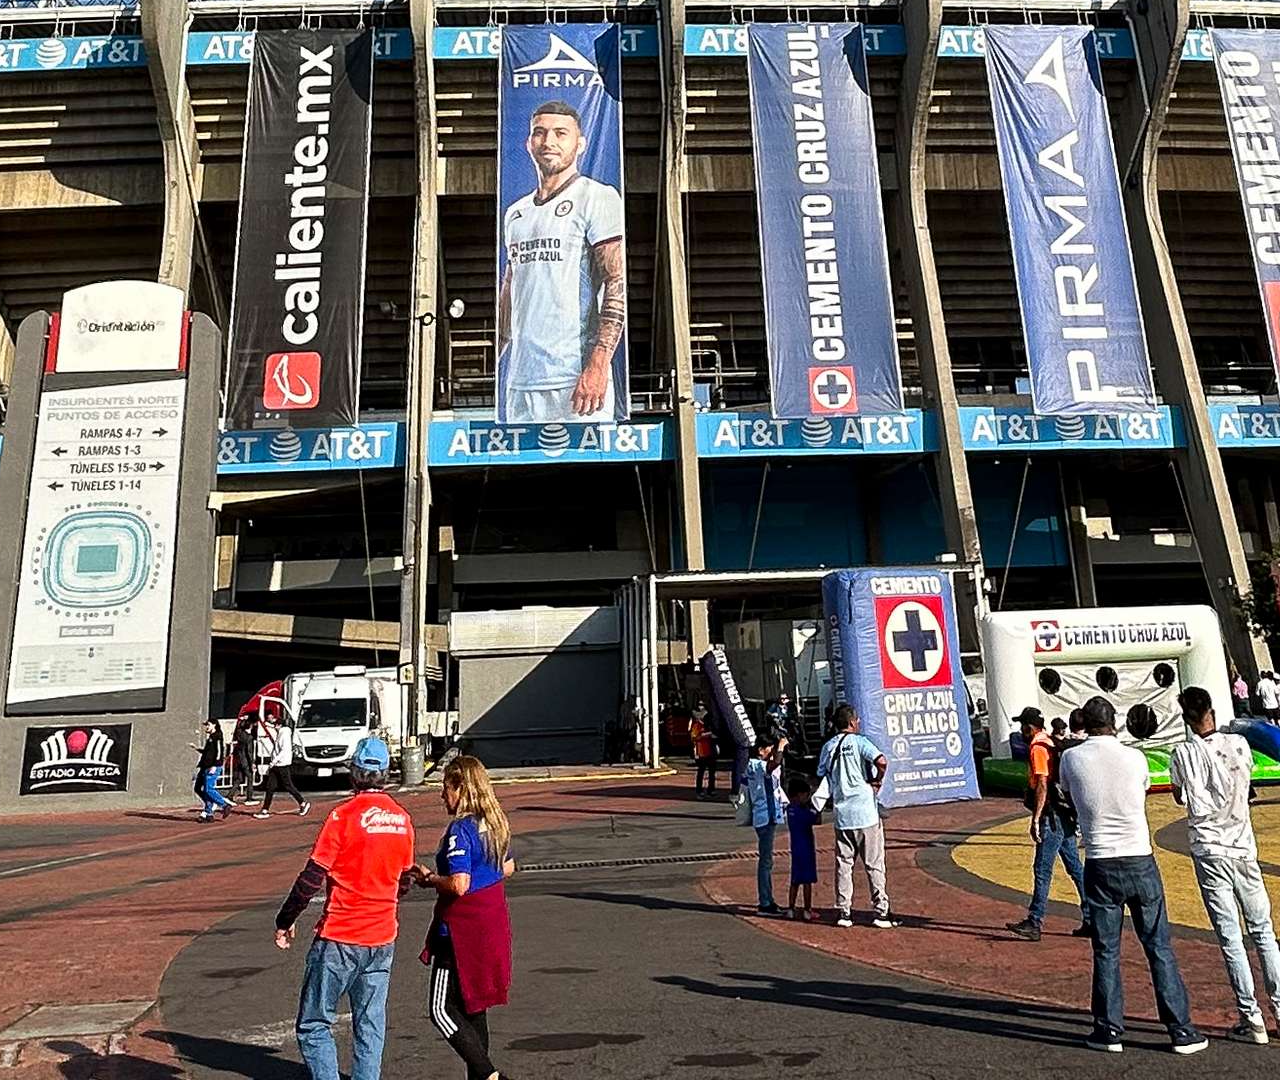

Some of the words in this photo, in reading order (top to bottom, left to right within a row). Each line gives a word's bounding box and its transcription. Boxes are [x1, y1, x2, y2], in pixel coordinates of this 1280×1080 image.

[72, 39, 144, 63] AT&T
[203, 34, 254, 60] AT&
[452, 31, 501, 55] AT&
[700, 29, 748, 51] AT&
[940, 29, 985, 52] AT&
[787, 25, 823, 99] AZUL
[513, 73, 605, 88] PIRMA
[793, 102, 831, 184] CRUZ
[274, 45, 334, 345] caliente.mx
[539, 252, 563, 261] AZUL
[1038, 129, 1123, 402] PIRMA
[800, 194, 846, 362] CEMENTO
[48, 396, 135, 407] INSURGENTES
[138, 395, 179, 405] NORTE
[47, 410, 100, 421] PUNTOS
[103, 411, 121, 420] DE
[124, 410, 178, 420] ACCESO
[80, 429, 123, 439] RAMPAS
[125, 428, 142, 438] 4-7
[448, 428, 528, 456] AT&T
[581, 423, 655, 452] AT&T
[714, 419, 789, 447] AT&T
[840, 417, 913, 445] AT&T
[971, 415, 1039, 442] AT&T
[1093, 414, 1162, 440] AT&T
[78, 446, 122, 456] RAMPAS
[124, 446, 141, 455] 1-3
[217, 436, 261, 464] &T
[310, 430, 392, 460] AT&T
[70, 461, 115, 474] TÚNELES
[118, 462, 146, 473] 15-30
[70, 479, 116, 491] TÚNELES
[118, 481, 141, 491] 1-14
[870, 576, 942, 595] CEMENTO
[1064, 624, 1126, 646] CEMENTO
[1128, 623, 1159, 643] CRUZ
[1162, 622, 1191, 641] AZUL
[884, 693, 924, 713] CRUZ
[926, 691, 957, 710] AZUL
[886, 711, 959, 736] BLANCO
[30, 768, 76, 779] ESTADIO
[78, 766, 120, 777] AZTECA
